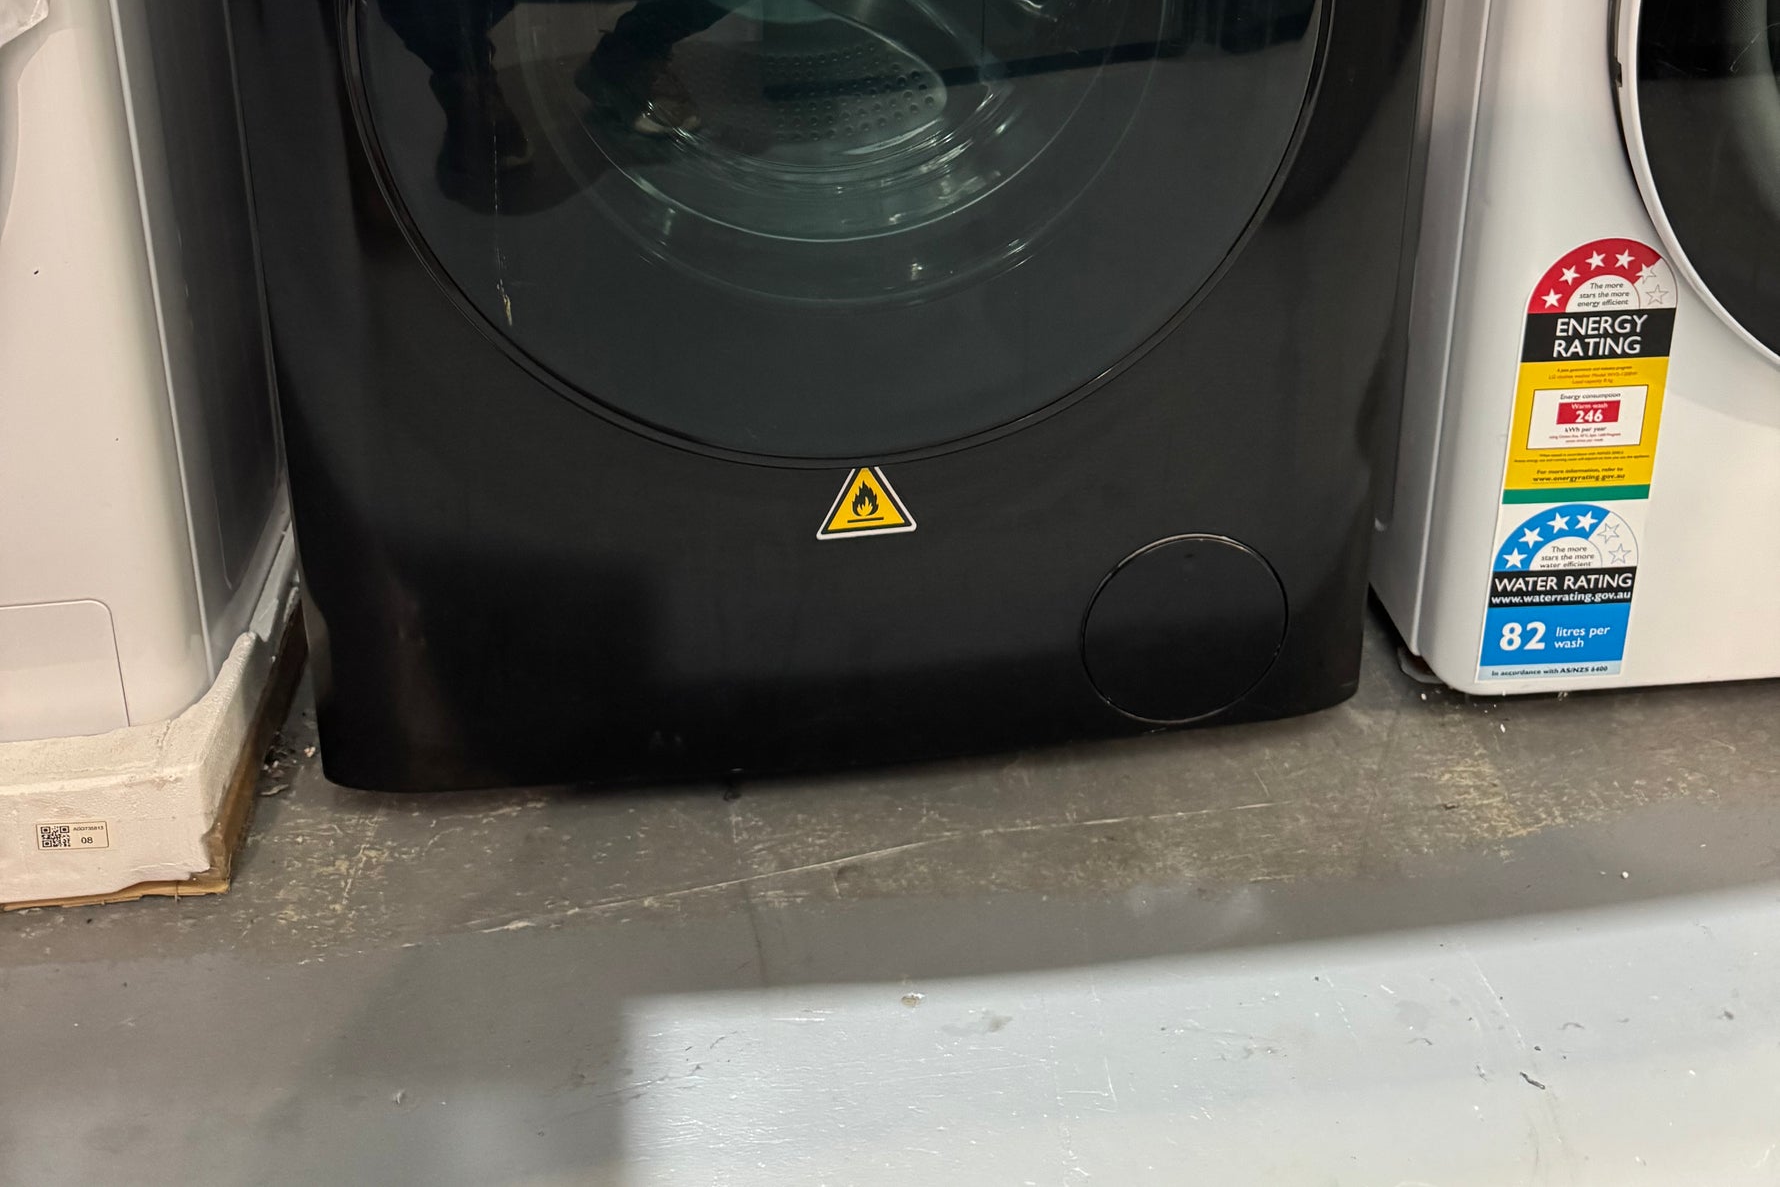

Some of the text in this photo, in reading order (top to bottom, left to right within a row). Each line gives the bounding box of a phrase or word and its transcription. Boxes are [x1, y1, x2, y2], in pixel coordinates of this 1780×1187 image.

[1577, 300, 1600, 308] energy
[1556, 314, 1648, 337] ENERGY
[1553, 335, 1642, 358] RATING
[1560, 392, 1621, 401] Energy consumption
[1575, 409, 1603, 423] 246
[1532, 473, 1626, 483] www.energyrating.gov.au
[1552, 545, 1565, 553] The
[1494, 573, 1633, 592] WATER RATING
[1491, 591, 1631, 604] www.waterrating.gov.au
[1500, 621, 1546, 651] 82
[1556, 626, 1610, 638] litres per
[1554, 637, 1585, 649] wash
[1543, 667, 1559, 675] with
[81, 836, 94, 844] 08
